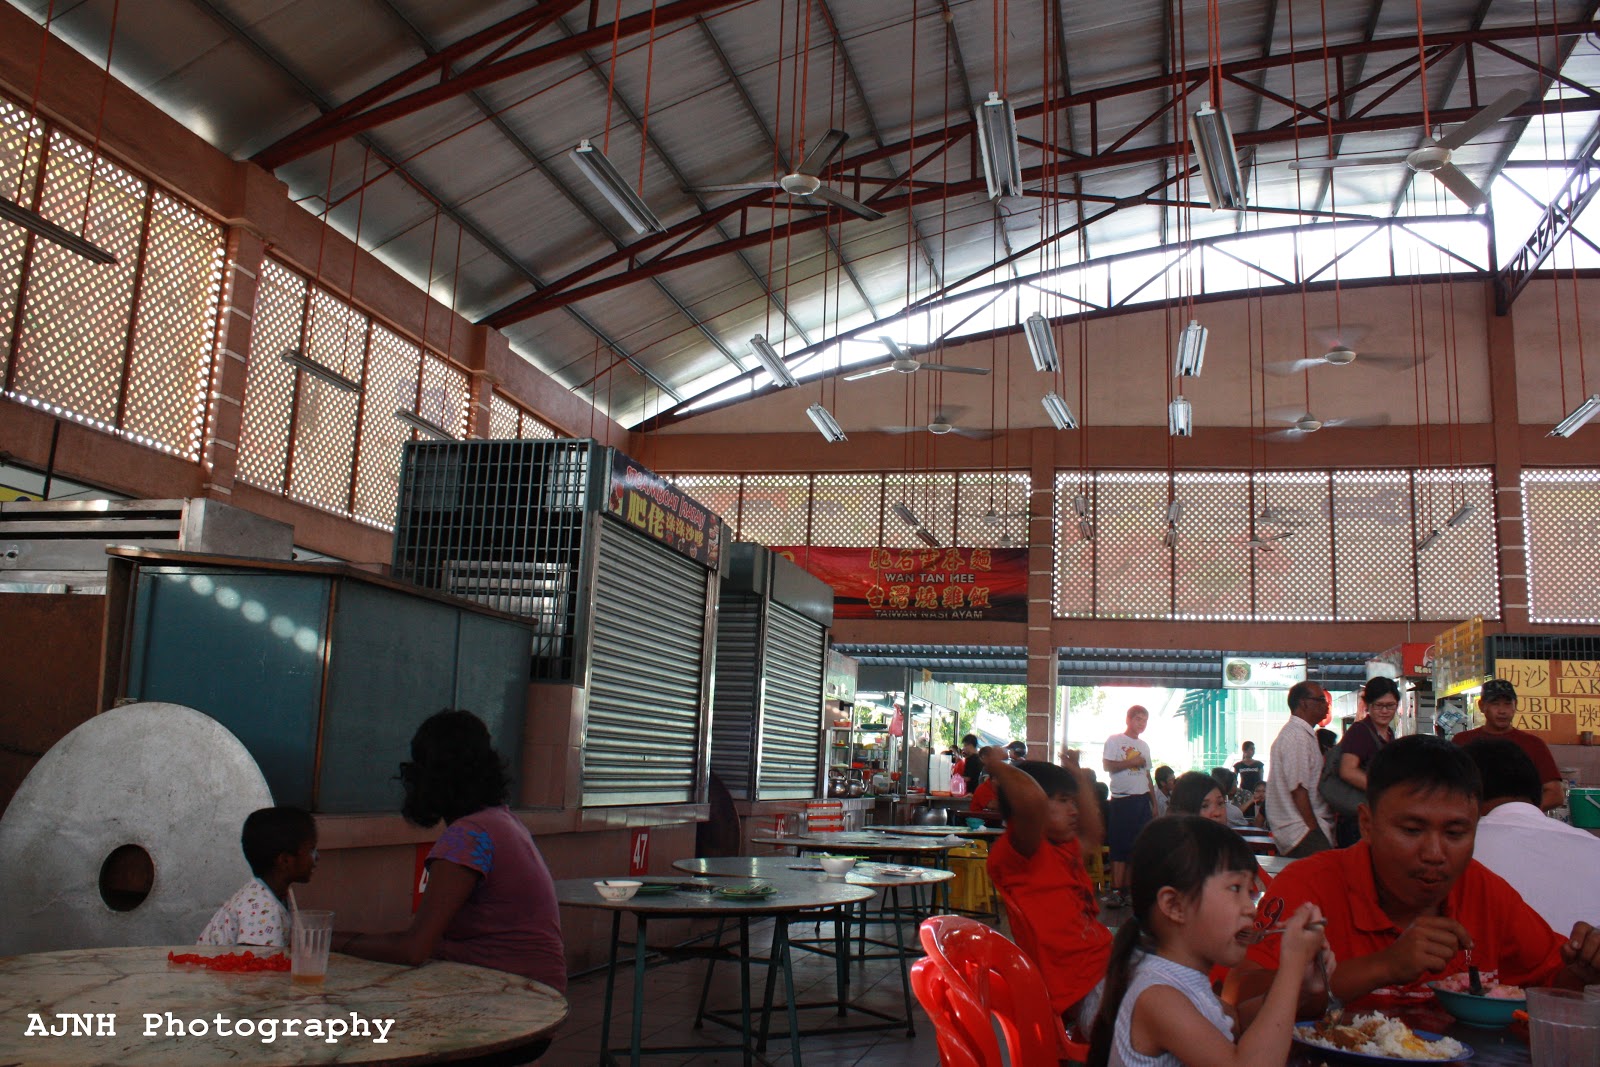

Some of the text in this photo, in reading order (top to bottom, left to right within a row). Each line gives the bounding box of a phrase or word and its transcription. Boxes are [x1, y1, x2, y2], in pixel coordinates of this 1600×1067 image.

[885, 573, 975, 583] WAN TAN MEE
[875, 610, 983, 619] TAIWAN NASI AYAM
[1516, 697, 1574, 714] UBUR
[1517, 715, 1549, 730] ASI
[633, 833, 648, 870] 47
